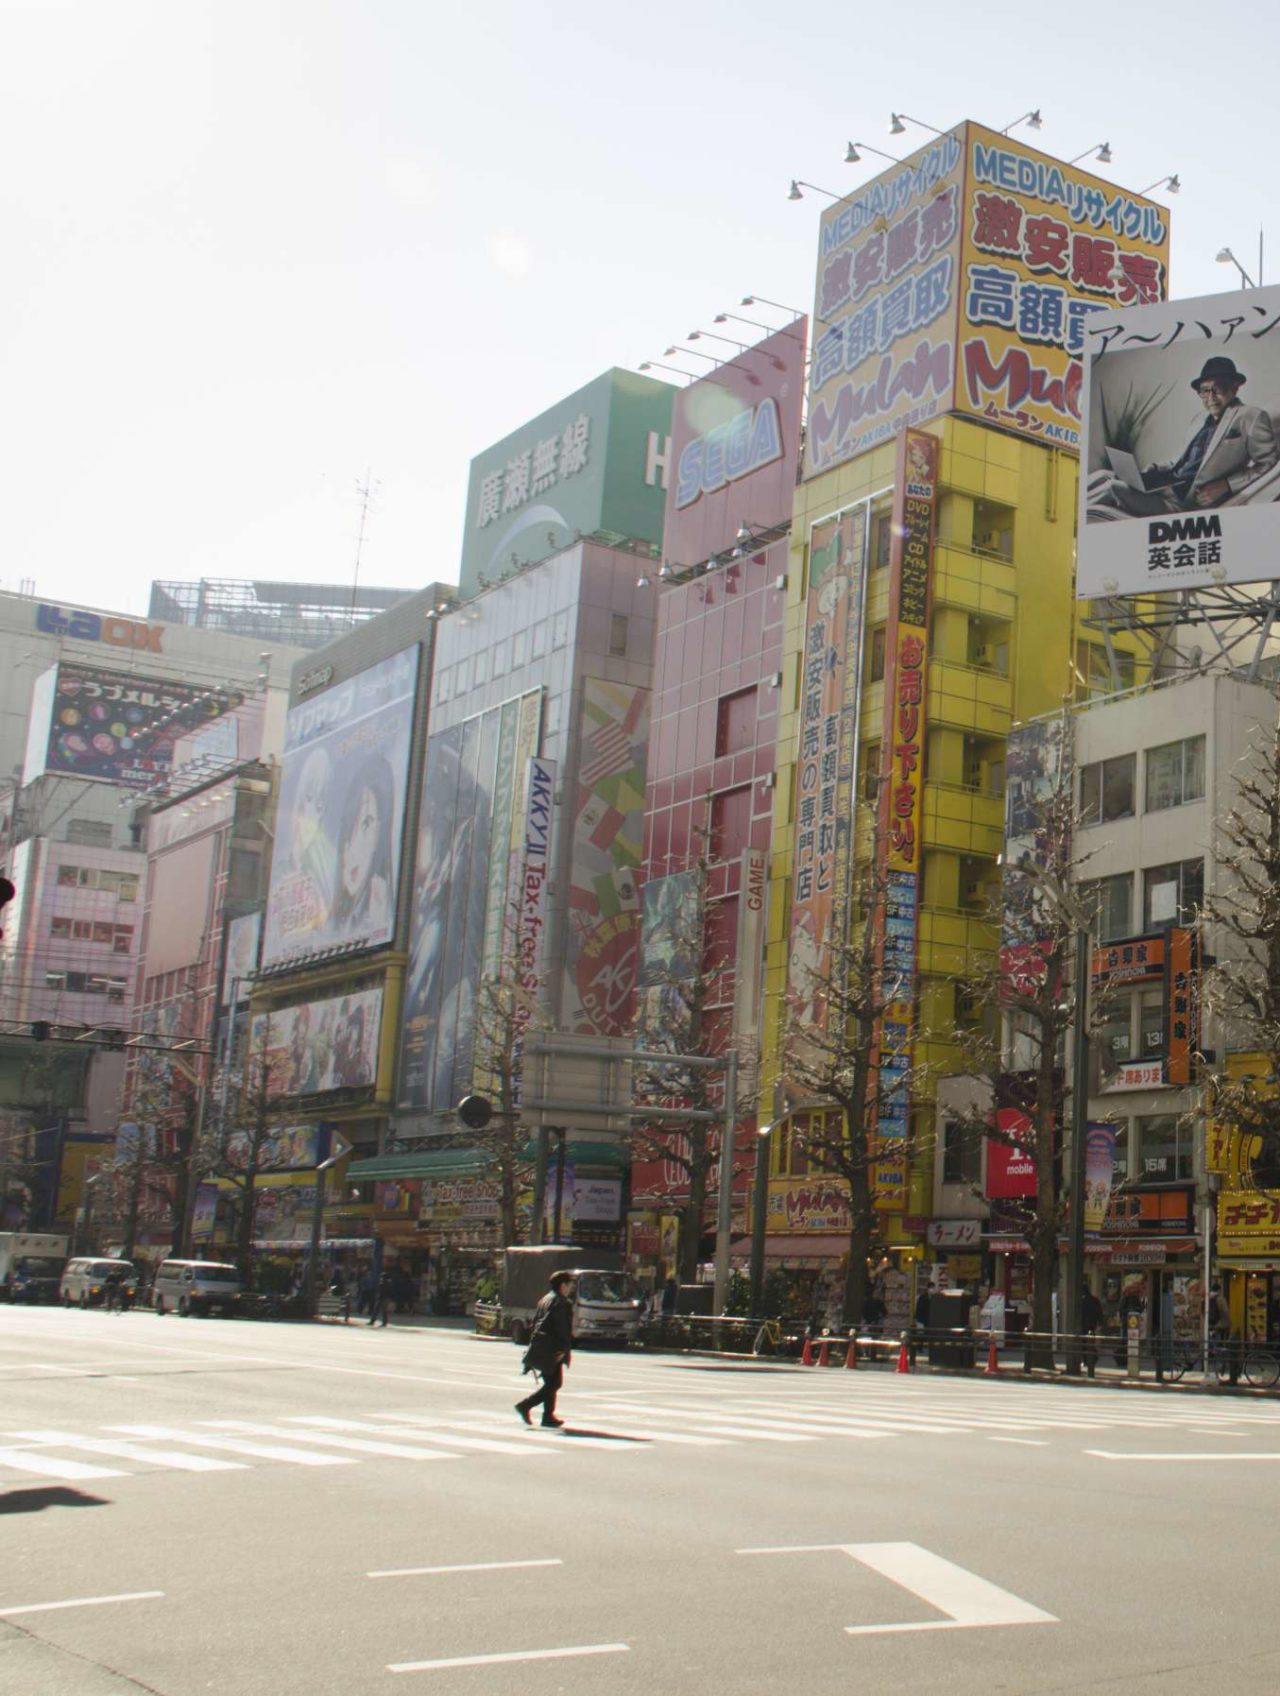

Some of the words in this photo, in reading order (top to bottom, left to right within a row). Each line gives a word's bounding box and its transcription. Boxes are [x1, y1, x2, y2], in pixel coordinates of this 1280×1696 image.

[972, 143, 1167, 244] MEDIAリサイクル
[972, 191, 1162, 305] 激安販売
[814, 254, 954, 389] 高額買取
[675, 397, 785, 511] SEGA
[907, 500, 930, 515] DVD
[1149, 514, 1222, 546] DMM
[908, 542, 924, 555] CD
[1147, 537, 1222, 571] 英会話
[746, 856, 765, 912] GAME
[1006, 1164, 1034, 1177] mobile
[933, 1226, 976, 1243] ラーメン
